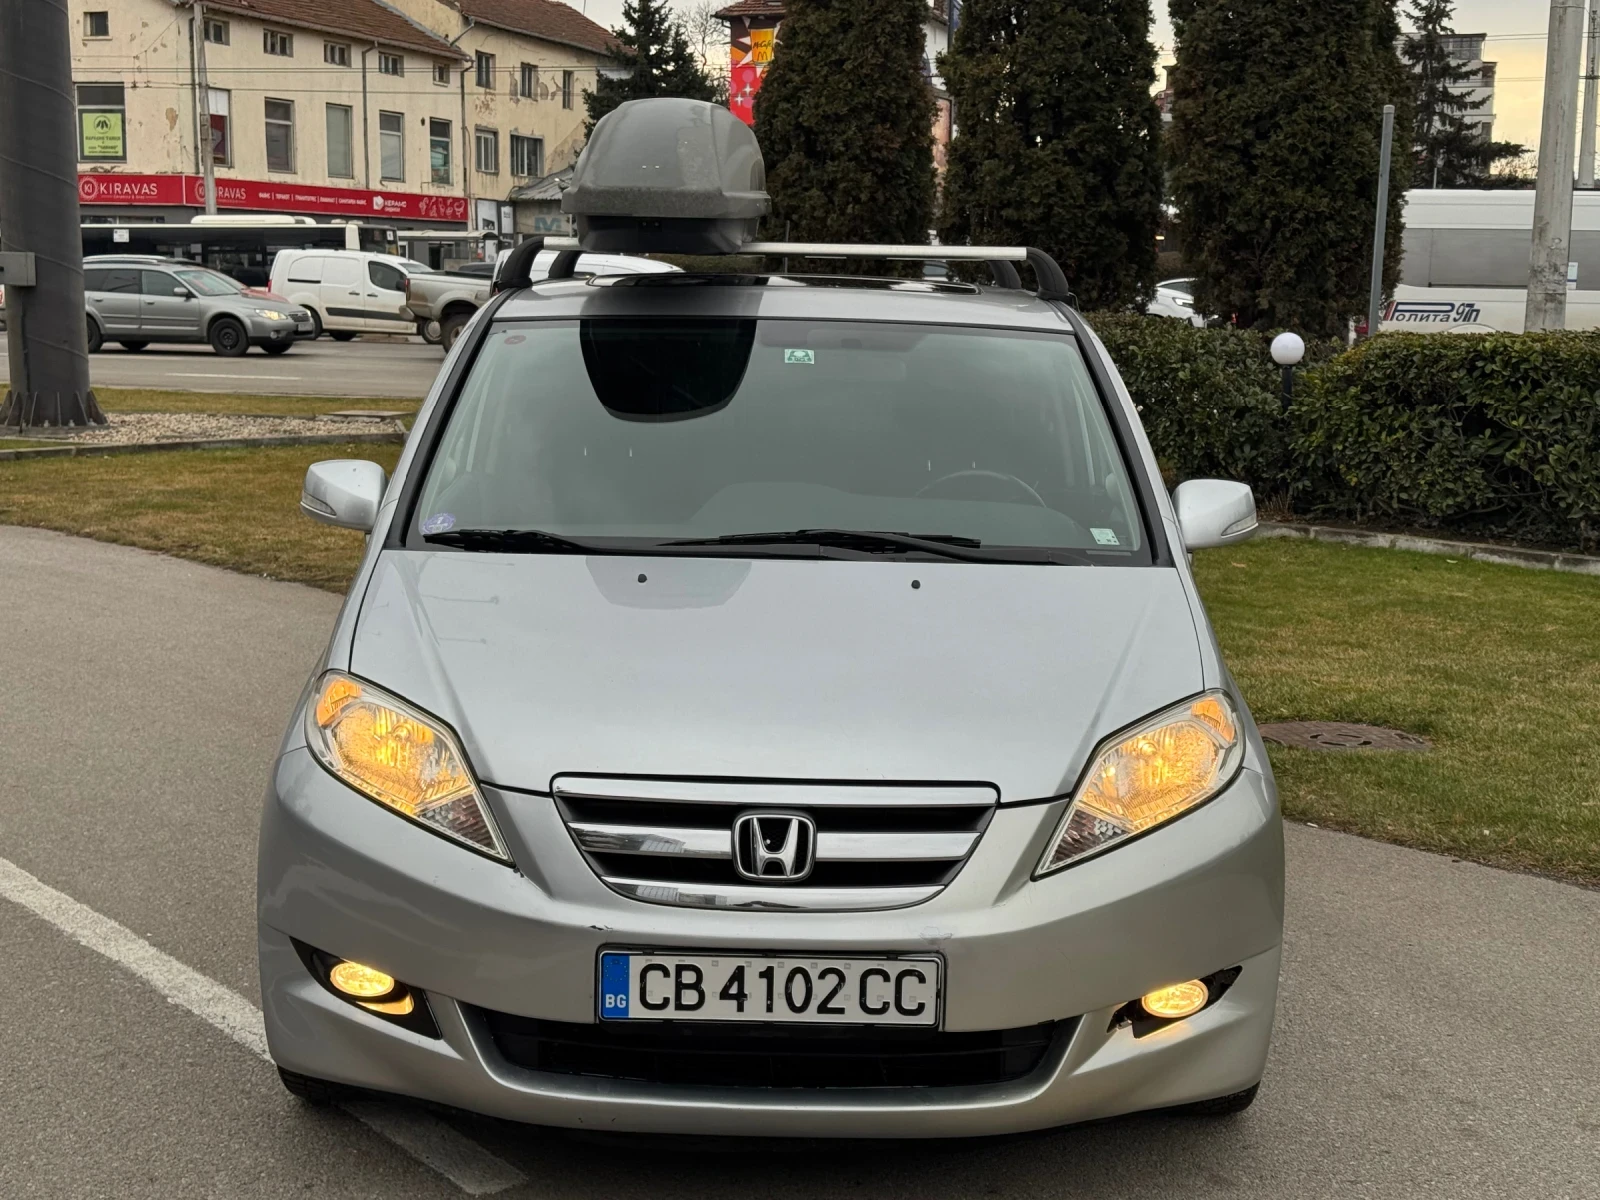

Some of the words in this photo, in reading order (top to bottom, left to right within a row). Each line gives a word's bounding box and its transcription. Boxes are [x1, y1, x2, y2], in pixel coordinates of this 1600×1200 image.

[100, 182, 158, 195] KIRAVAS
[719, 965, 847, 1015] 4102
[605, 994, 627, 1009] BG
